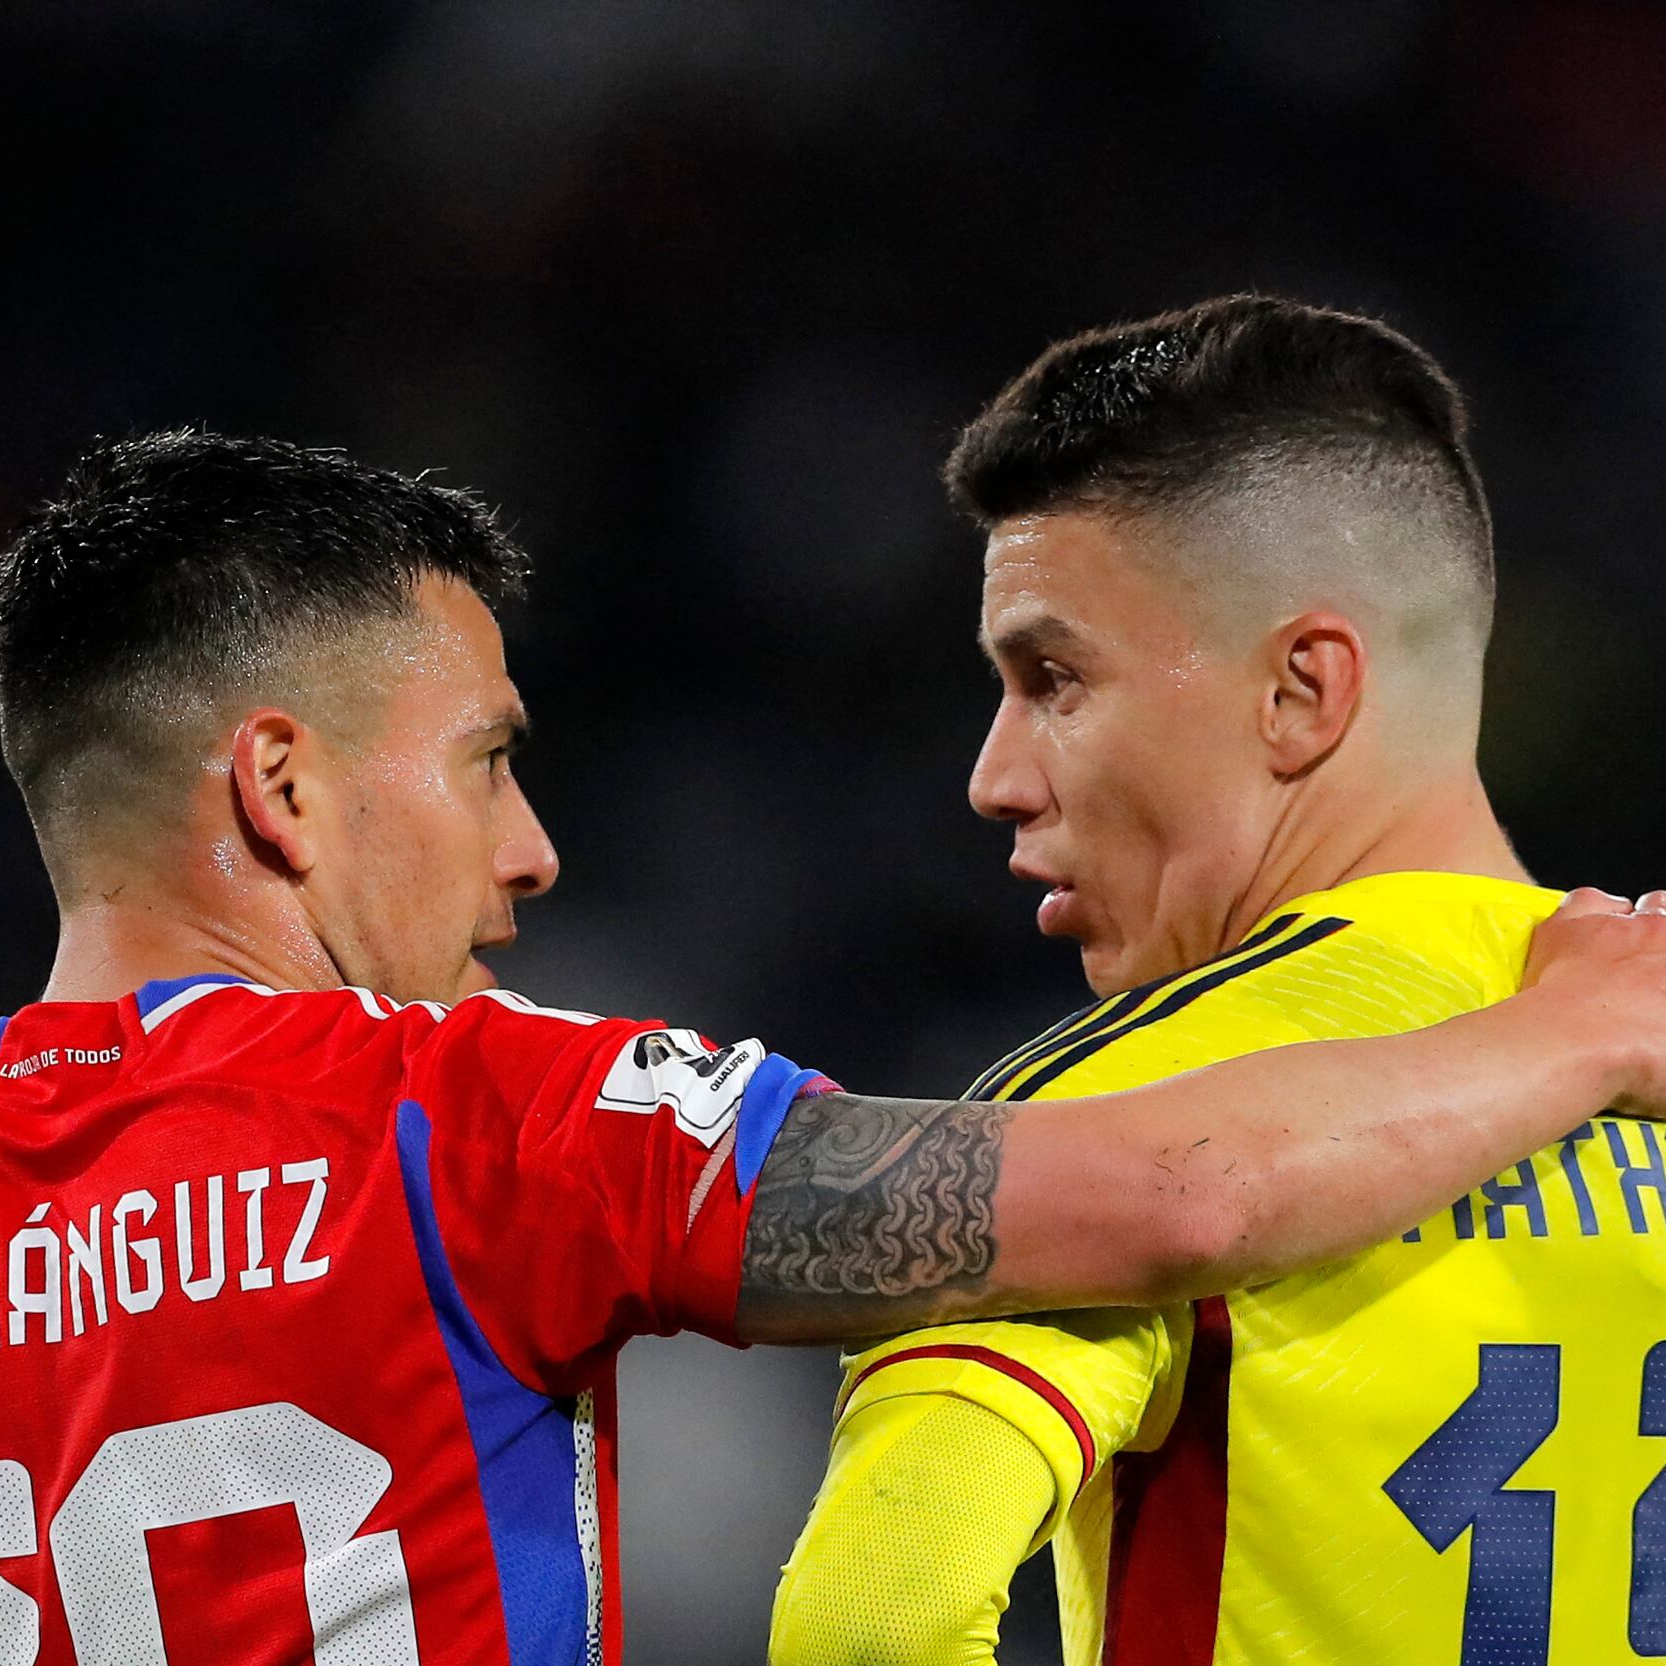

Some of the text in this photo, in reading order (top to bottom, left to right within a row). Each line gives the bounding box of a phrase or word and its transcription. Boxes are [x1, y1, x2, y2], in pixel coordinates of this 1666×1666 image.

[18, 1055, 42, 1078] RO
[40, 1048, 59, 1068] DE
[64, 1045, 121, 1065] TODOS
